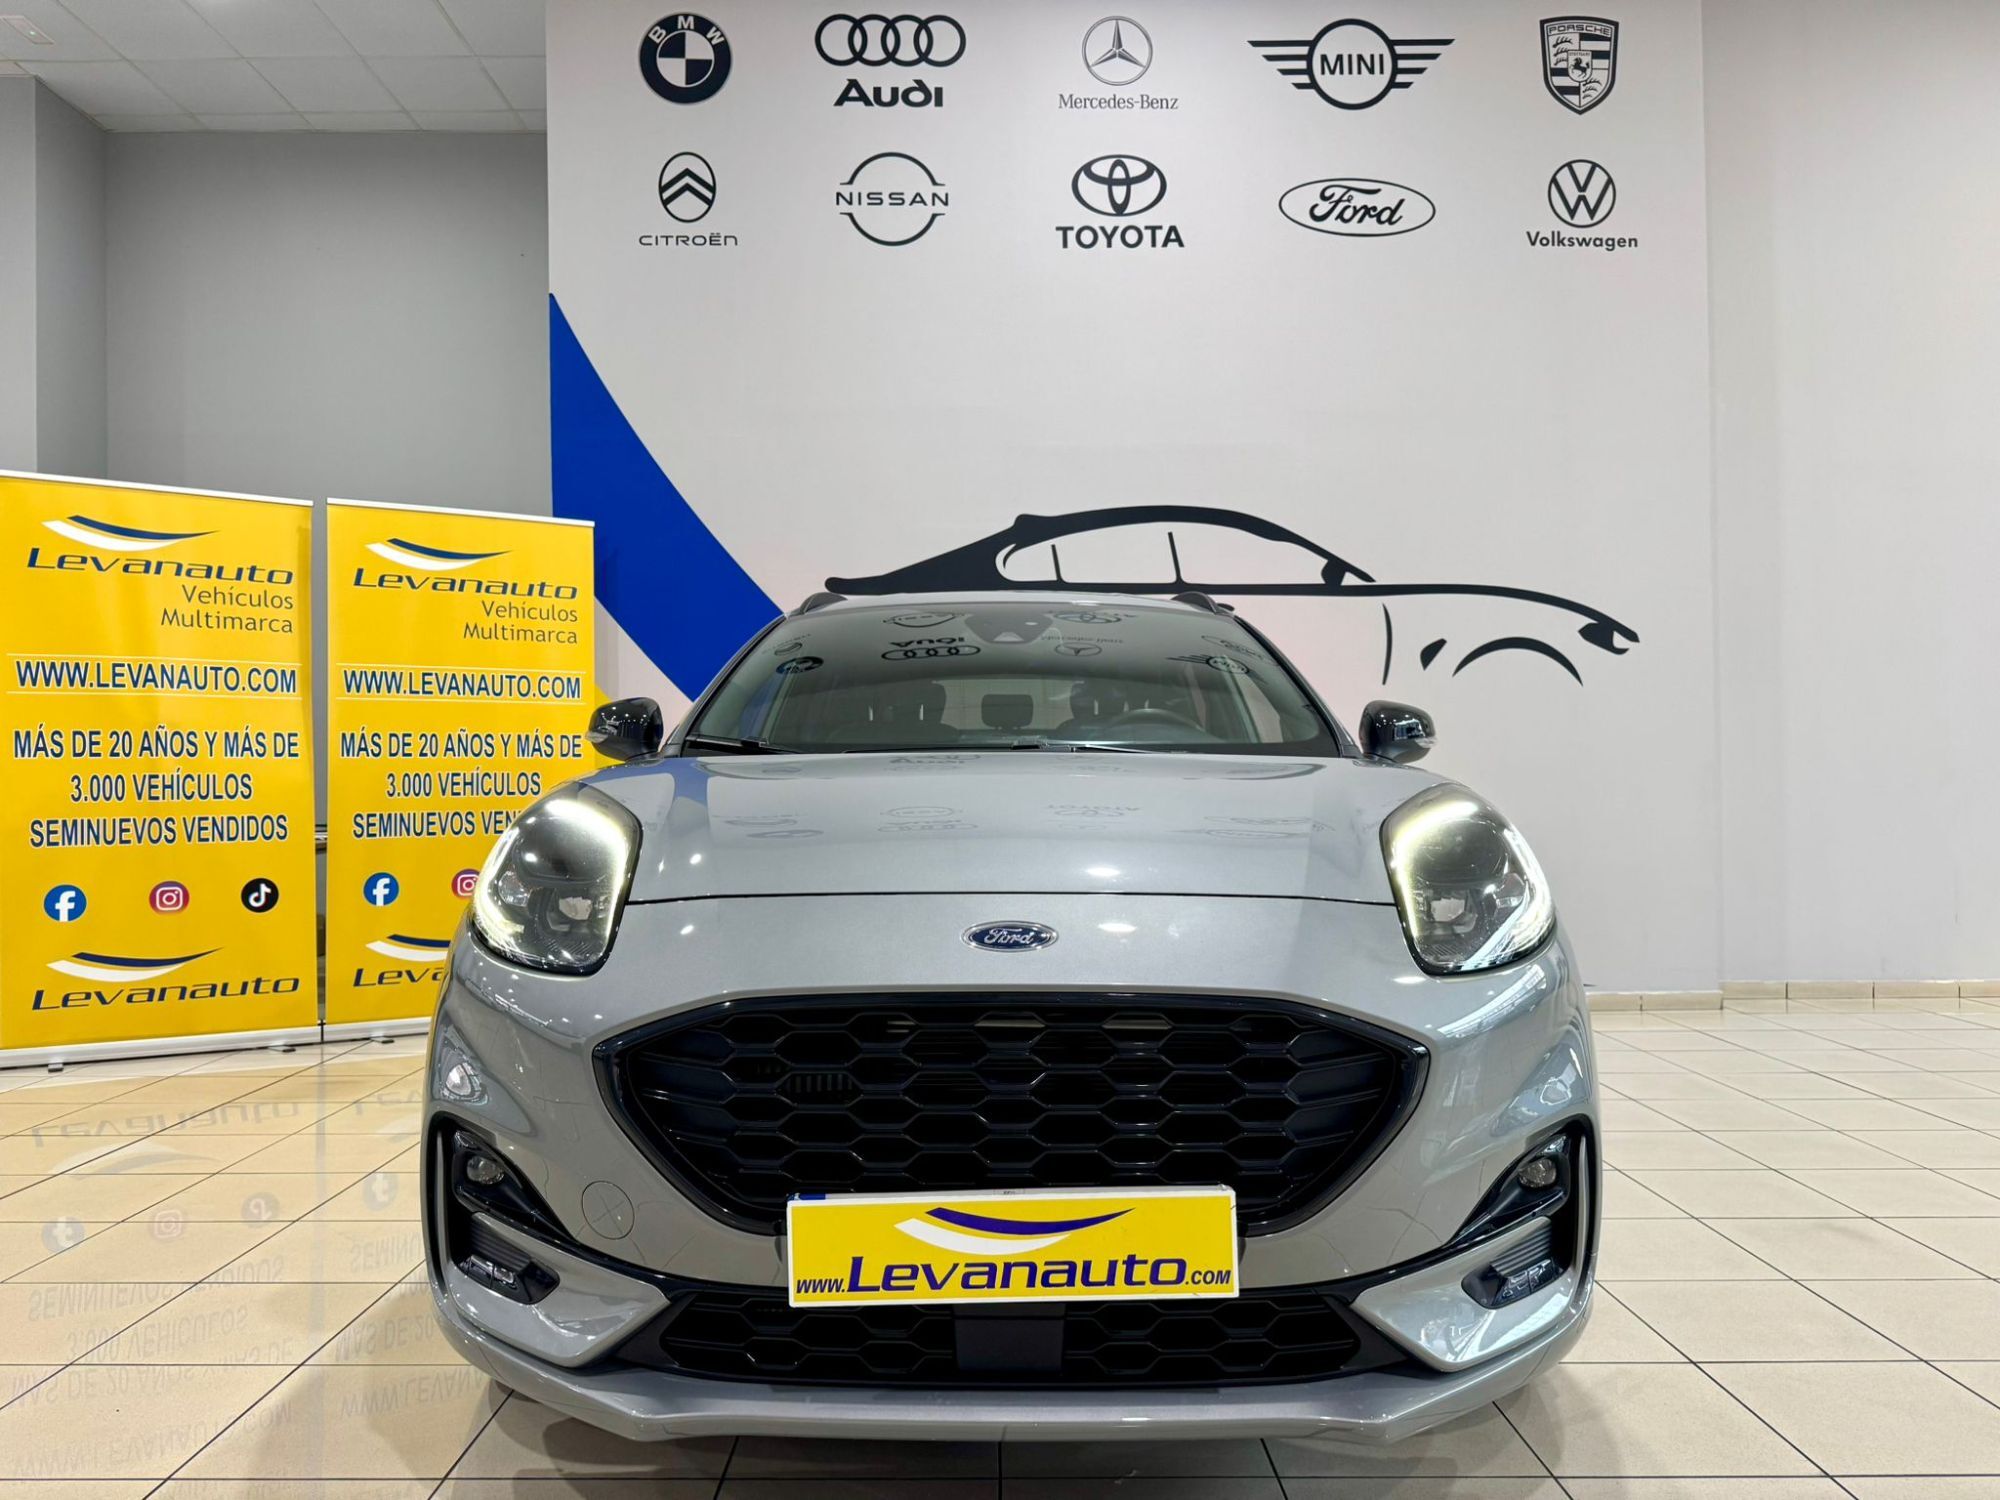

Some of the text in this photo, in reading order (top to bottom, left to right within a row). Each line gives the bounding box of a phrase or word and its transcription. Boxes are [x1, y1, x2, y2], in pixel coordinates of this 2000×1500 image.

[648, 14, 724, 48] BMW
[1548, 24, 1610, 36] PORSCHE
[1320, 53, 1384, 75] MINI
[833, 78, 943, 108] Audi
[1059, 94, 1178, 109] Mercedes-Benz
[836, 192, 949, 206] NISSAN
[1309, 184, 1405, 226] Ford
[1055, 225, 1184, 249] TOYOTA
[1526, 230, 1638, 251] Volkswagen
[27, 548, 294, 584] Levanauto
[182, 584, 294, 610] Vehículos
[353, 568, 578, 599] Levanauto
[161, 607, 294, 634] Multimarca
[482, 600, 578, 622] Vehículos
[464, 621, 577, 644] Multimarca
[16, 660, 296, 693] WWW.LEVANAUTO.COM
[343, 670, 580, 698] WWW.LEVANAUTO.COM
[15, 724, 299, 757] MÁS DE 20 AÑOS Y MÁS DE
[342, 727, 581, 758] MÁS DE 20 AÑOS Y MÁS DE
[70, 768, 251, 801] 3.000 VEHÍCULOS
[386, 766, 541, 798] 3.000 VEHÍCULOS
[31, 815, 287, 847] SEMINUEVOS VENDIDOS
[354, 810, 522, 838] SEMINUEVOS VEN
[984, 928, 1034, 944] Ford
[33, 978, 299, 1010] Levanauto
